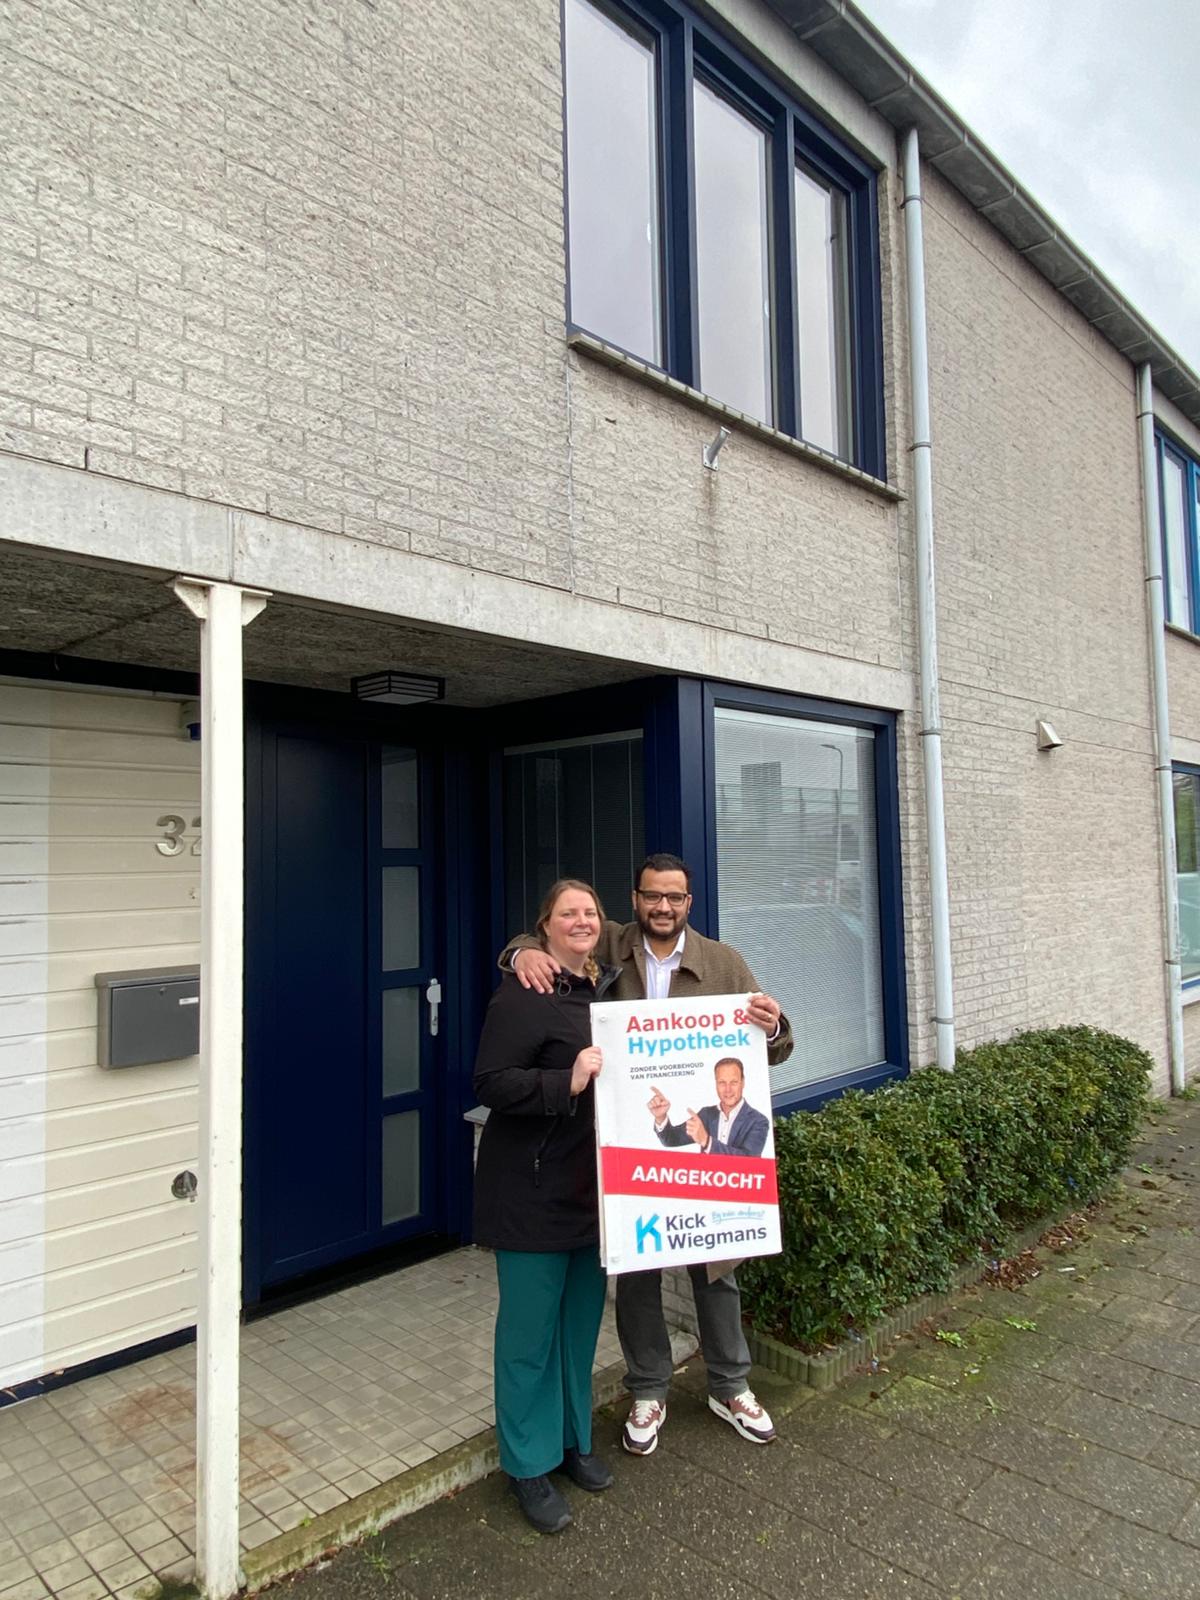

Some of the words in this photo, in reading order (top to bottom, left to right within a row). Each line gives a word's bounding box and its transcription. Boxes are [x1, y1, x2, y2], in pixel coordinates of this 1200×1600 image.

[626, 1012, 725, 1033] Aankoop
[733, 1008, 750, 1026] &
[628, 1029, 750, 1057] Hypotheek
[630, 1065, 657, 1073] ZONDER
[658, 1062, 705, 1071] VOORBEHOUD
[646, 1070, 696, 1079] FINANCIERING
[631, 1165, 766, 1190] AANGEKOCHT
[665, 1212, 707, 1232] Kick
[667, 1227, 767, 1250] Wiegmans
